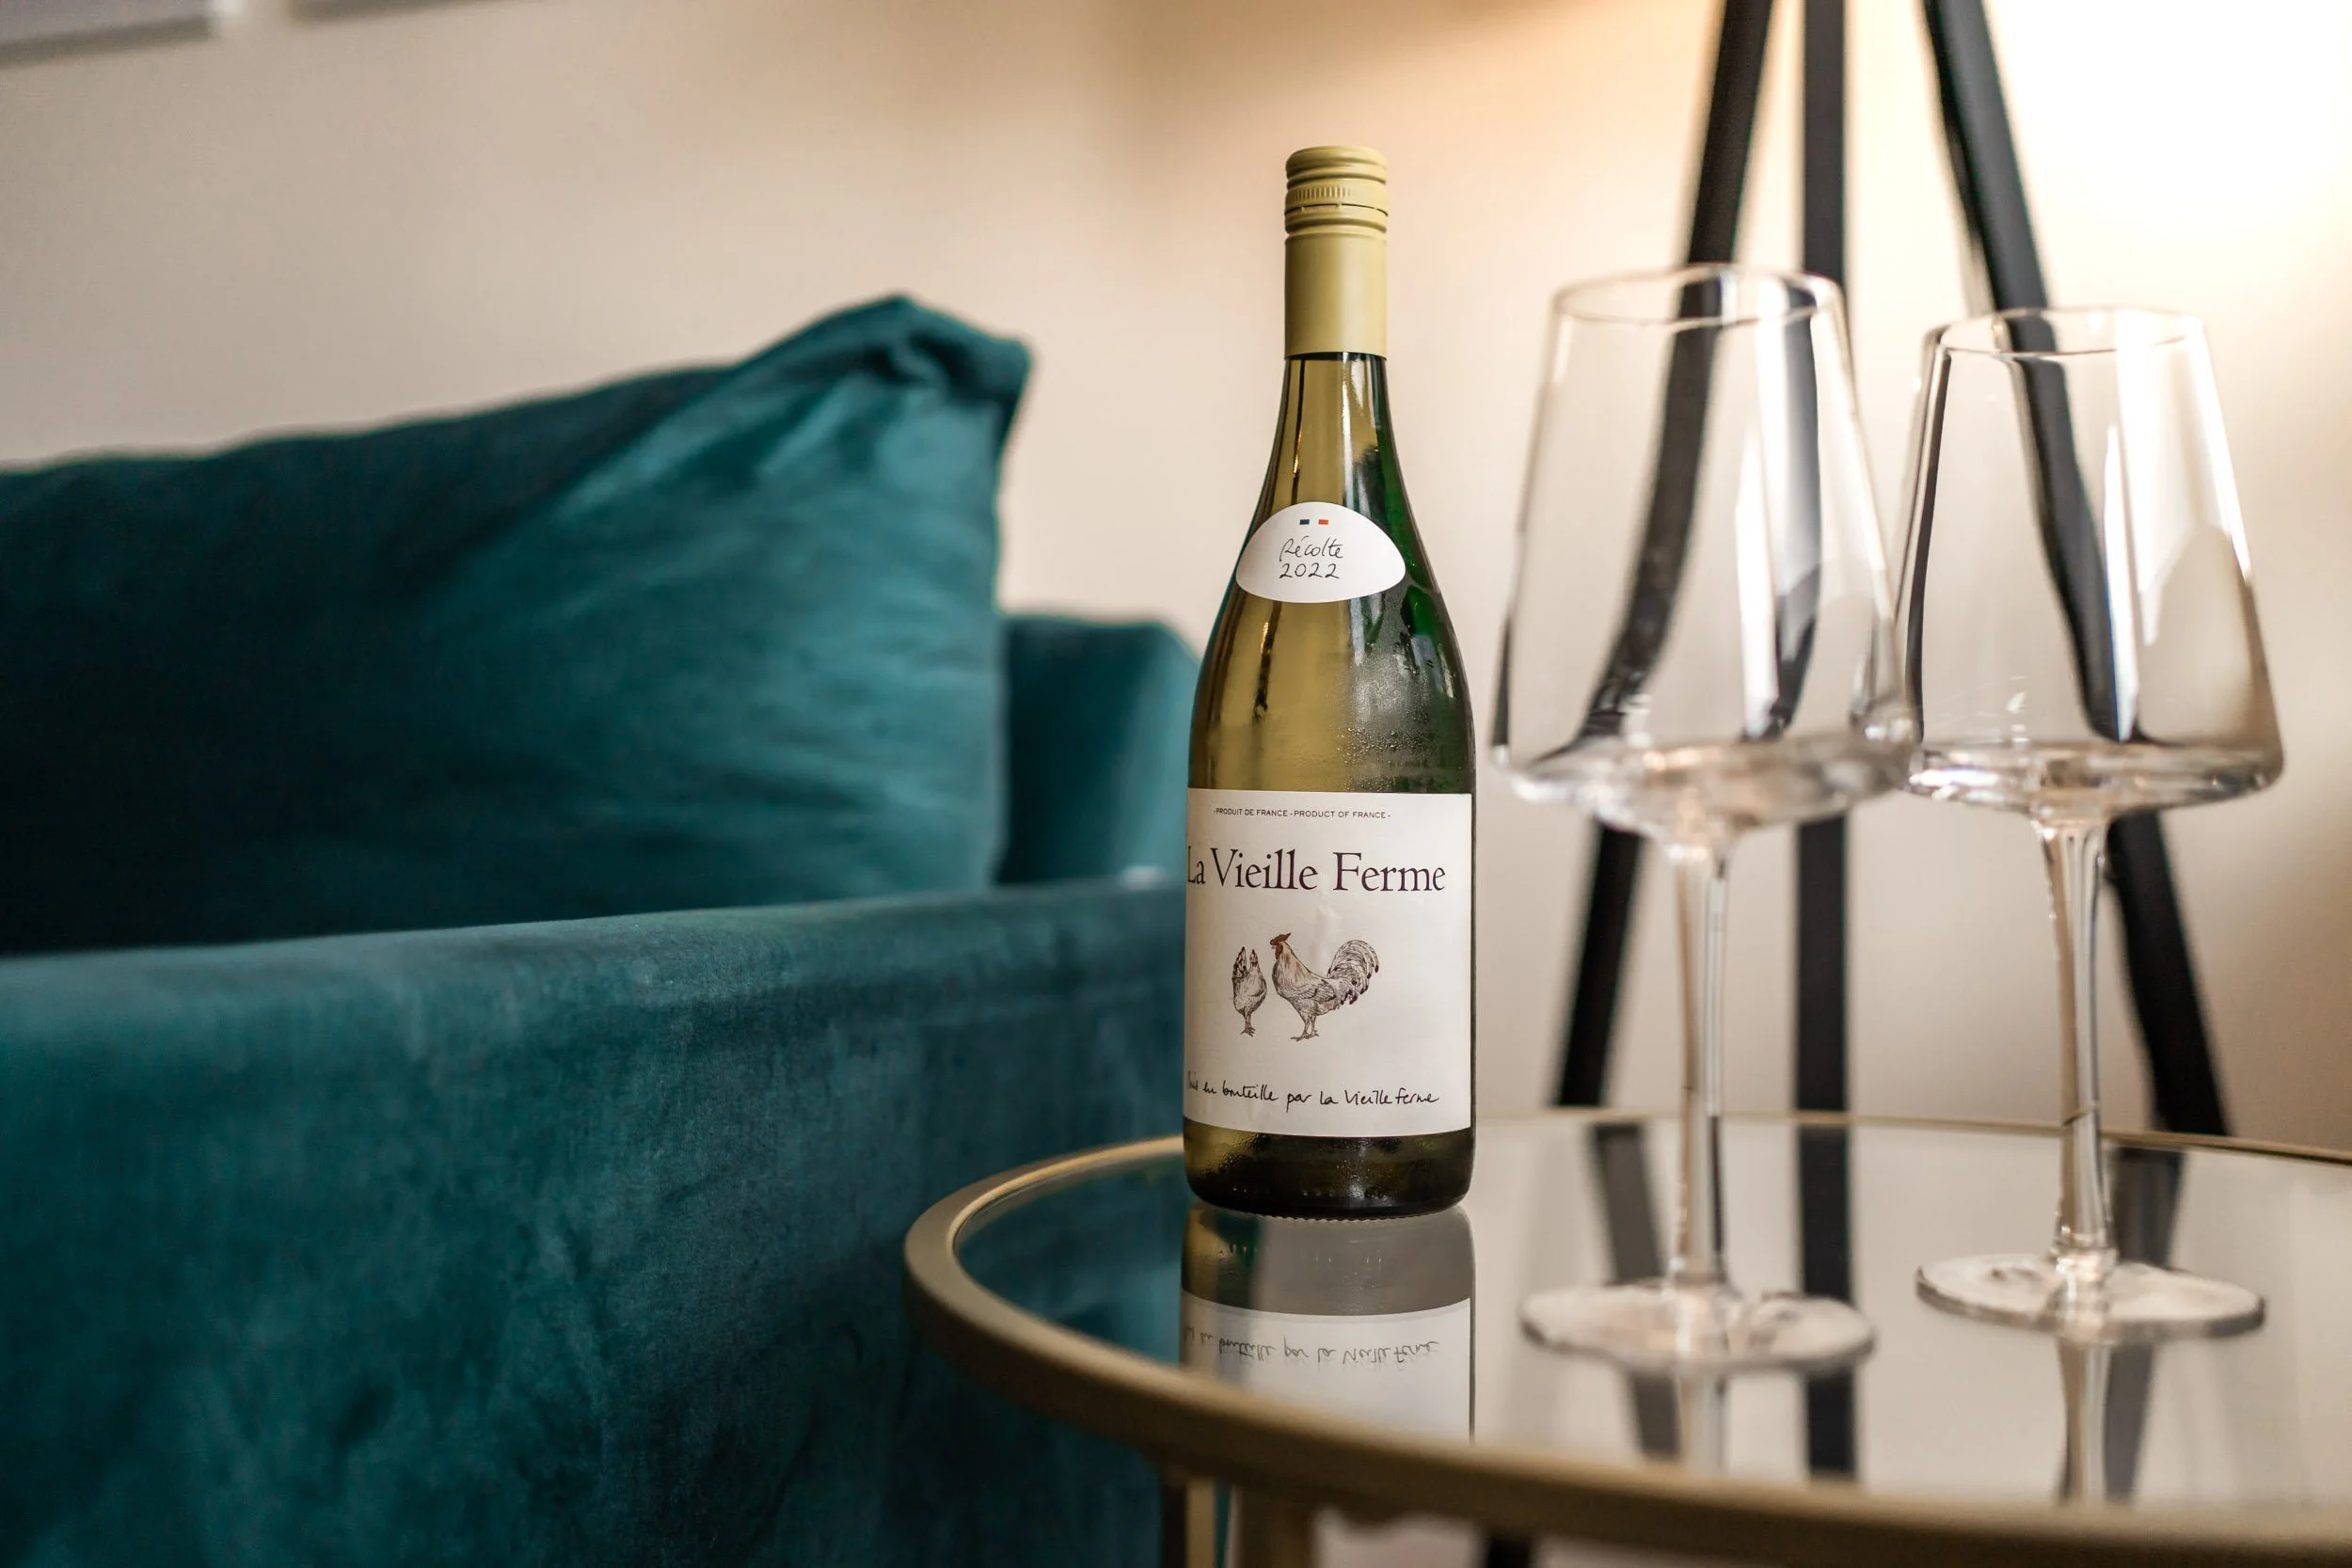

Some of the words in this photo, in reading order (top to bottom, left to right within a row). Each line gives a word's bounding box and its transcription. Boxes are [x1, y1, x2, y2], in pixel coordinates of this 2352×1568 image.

[1279, 535, 1343, 562] Récolte
[1279, 562, 1340, 579] 2022
[1216, 808, 1243, 816] PRODUIT
[1256, 809, 1288, 817] FRANCE
[1294, 810, 1335, 818] PRODUCT
[1352, 811, 1387, 819] FRANCE
[1187, 845, 1206, 884] La
[1209, 847, 1319, 890] Vieille
[1332, 851, 1446, 892] Ferme
[1222, 1079, 1279, 1101] bouteille
[1285, 1092, 1312, 1114] par
